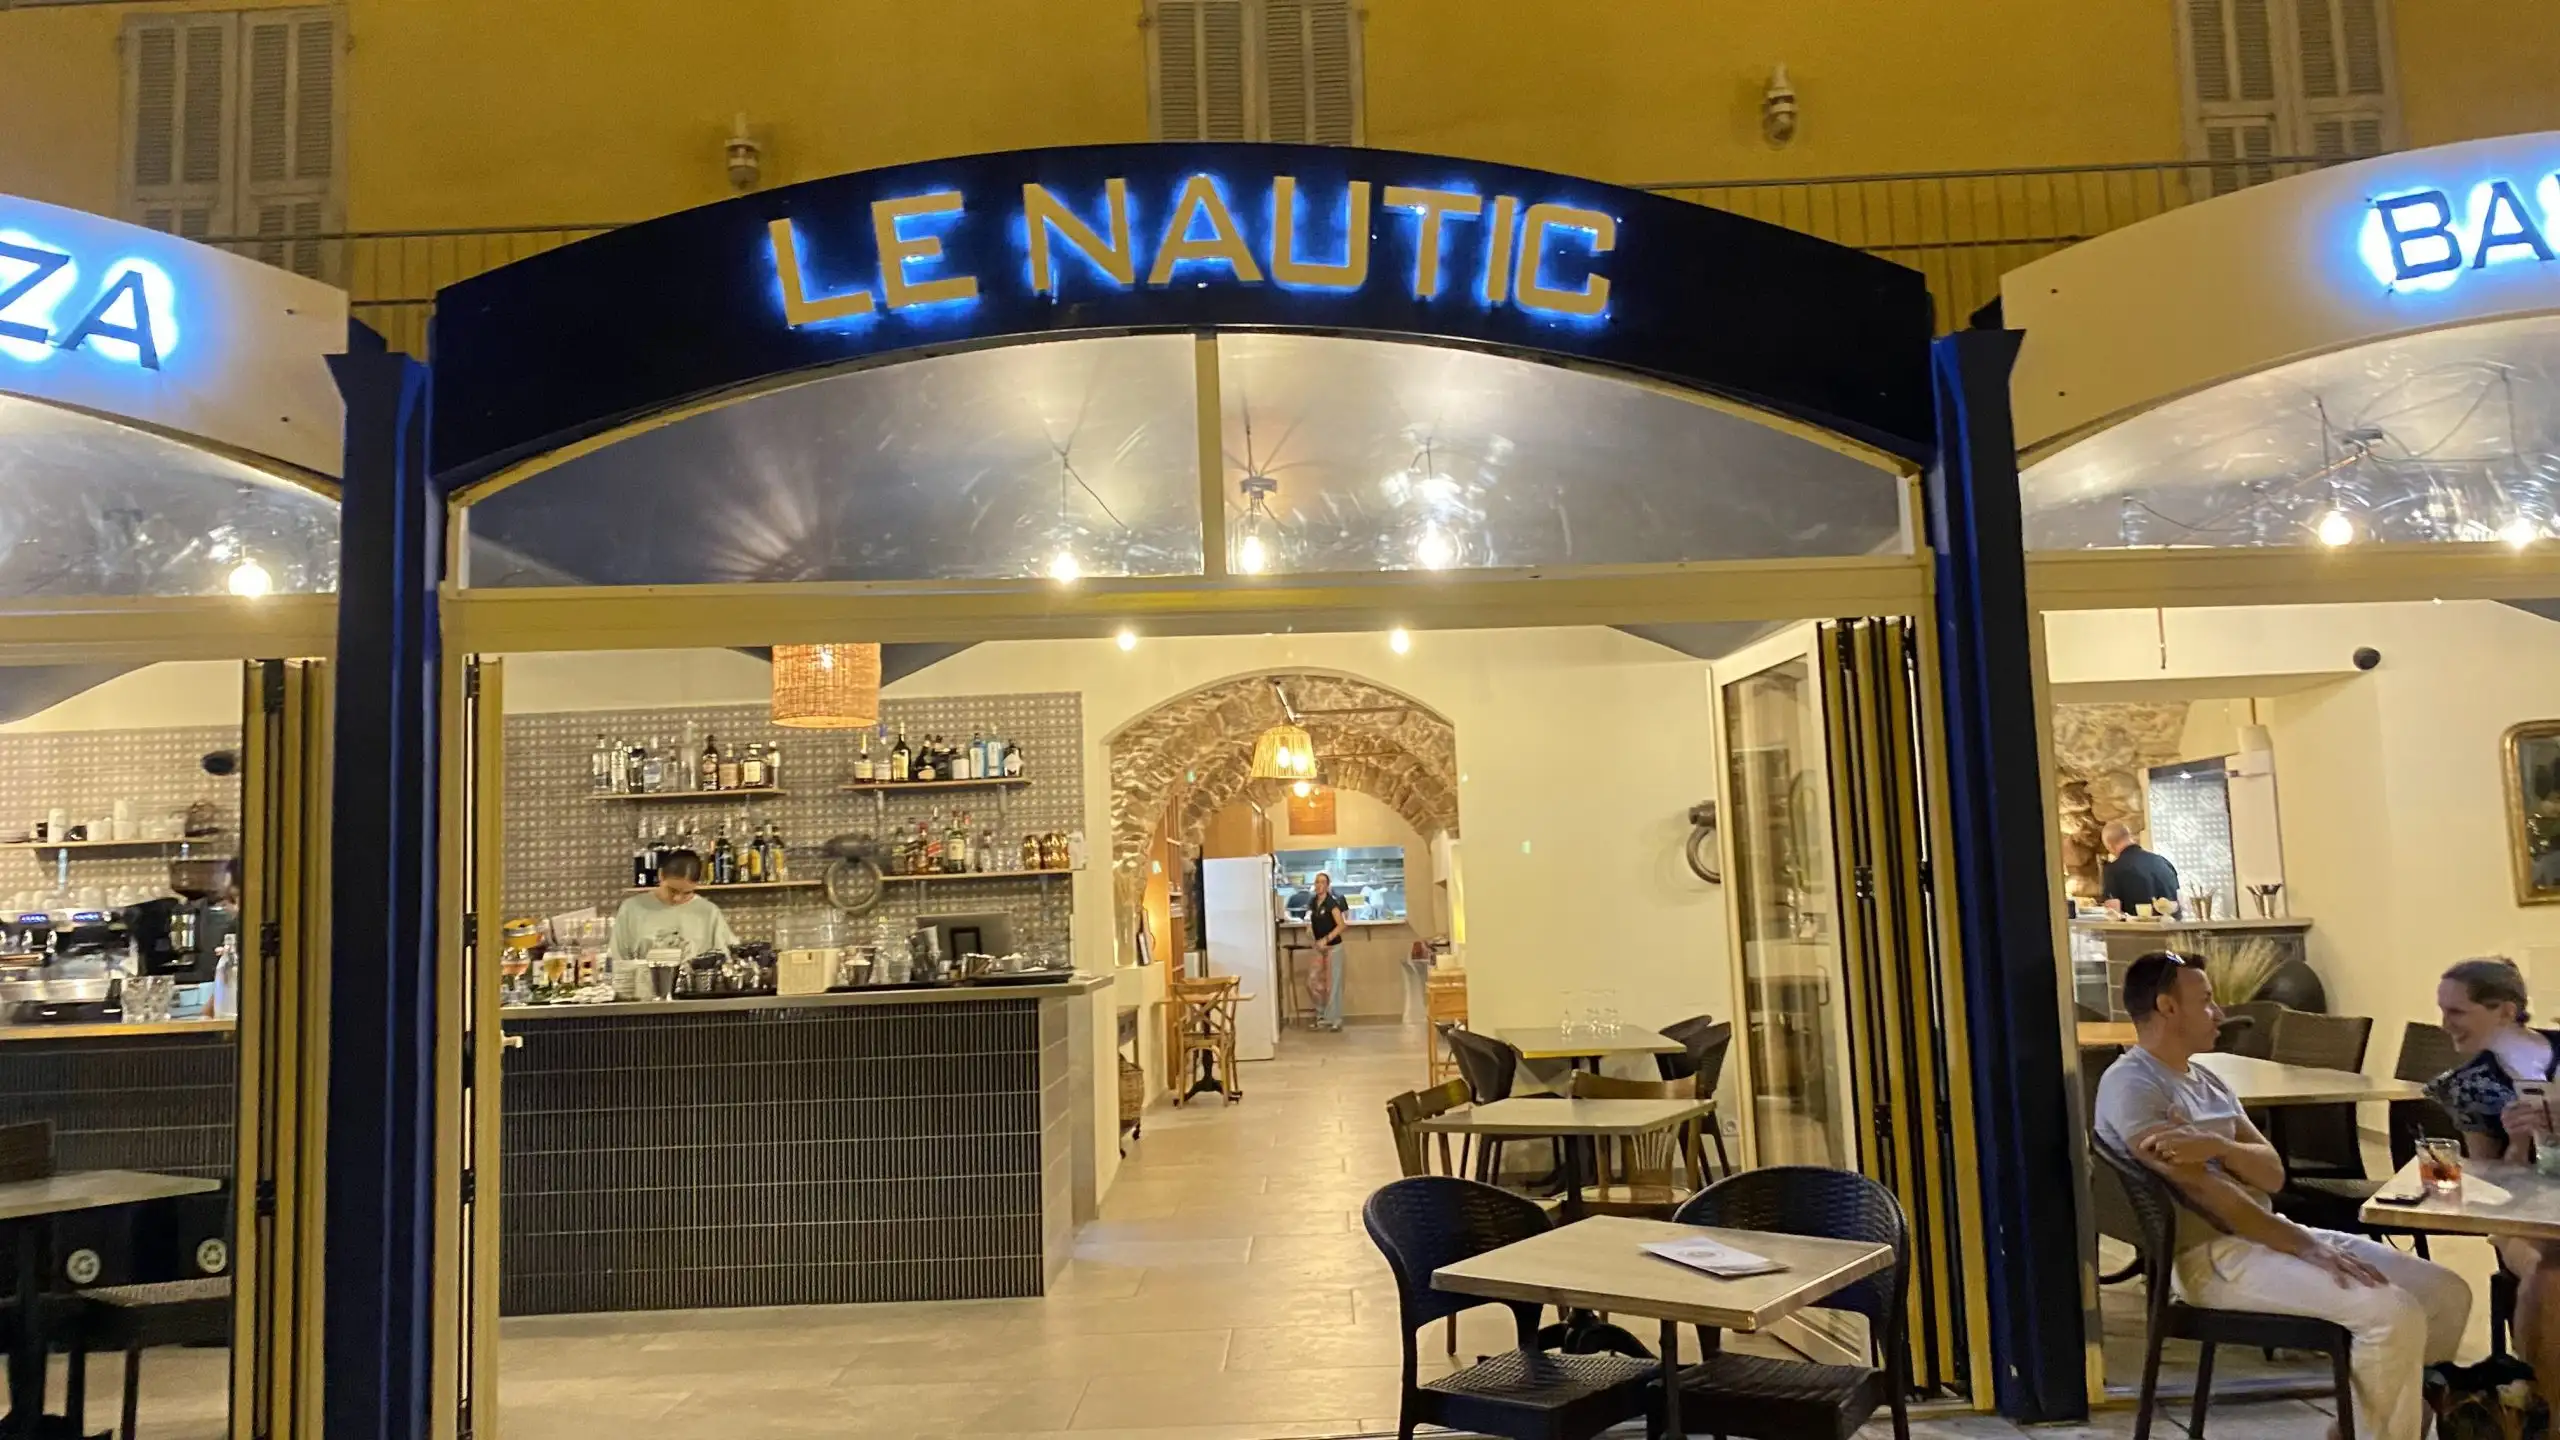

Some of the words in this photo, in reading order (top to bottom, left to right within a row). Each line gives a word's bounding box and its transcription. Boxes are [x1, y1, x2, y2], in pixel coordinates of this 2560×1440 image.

[768, 190, 978, 326] LE
[1022, 175, 1616, 316] NAUTIC
[2375, 174, 2560, 281] BA
